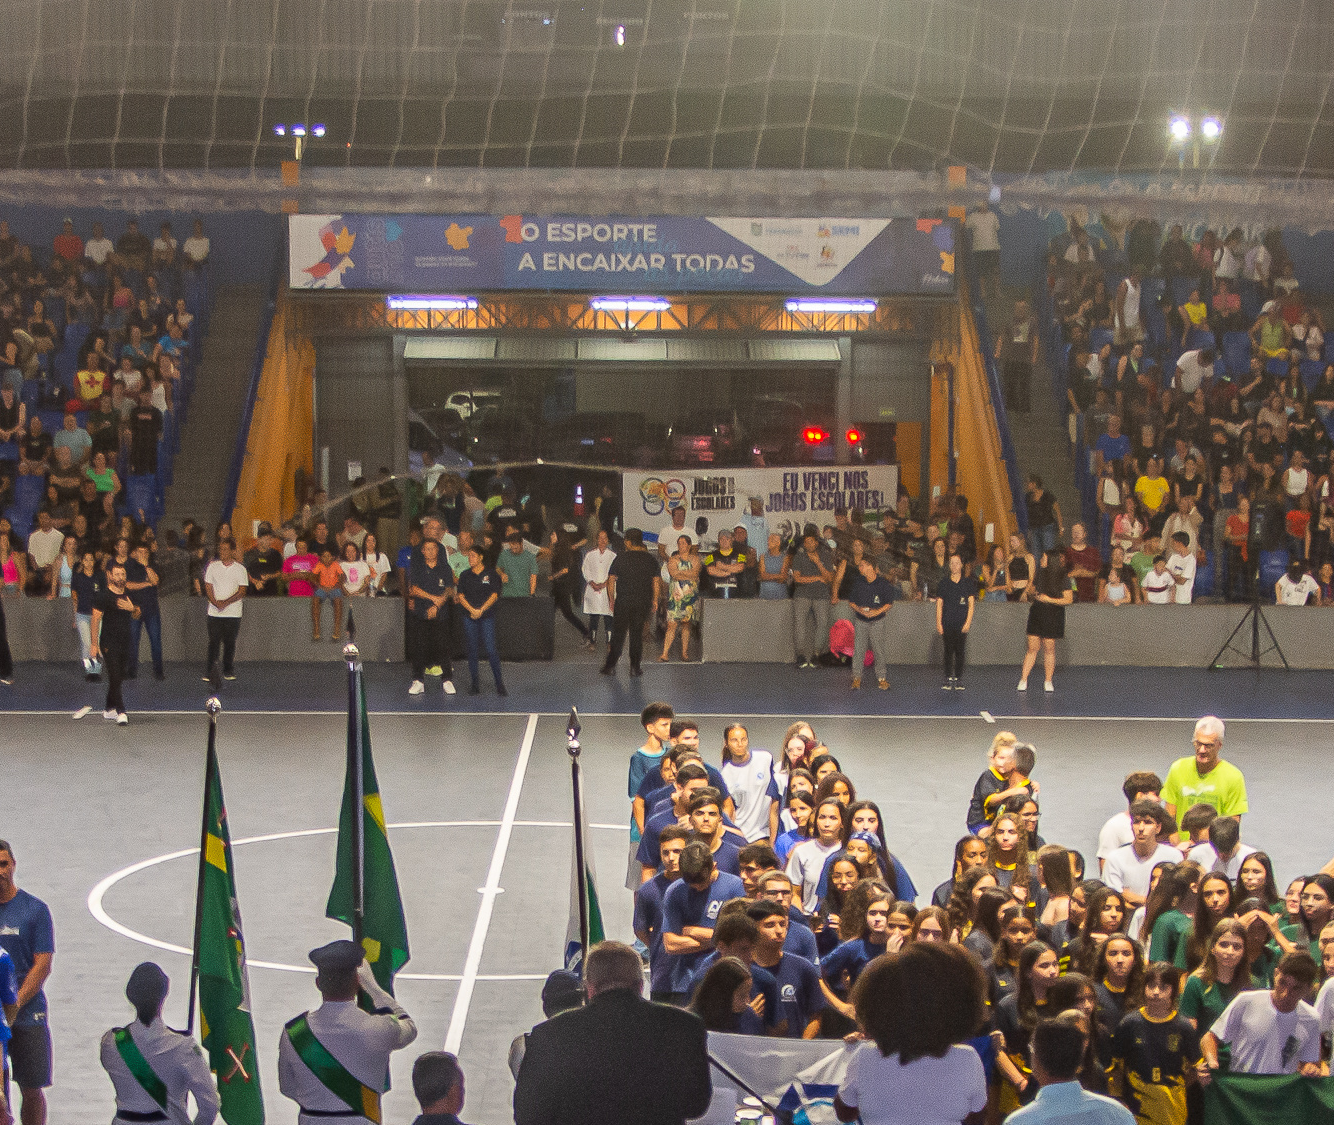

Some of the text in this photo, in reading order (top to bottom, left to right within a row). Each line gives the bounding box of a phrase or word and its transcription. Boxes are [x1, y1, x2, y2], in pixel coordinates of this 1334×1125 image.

[520, 223, 540, 242] O
[547, 223, 657, 243] ESPORTE
[518, 252, 536, 271] A
[543, 252, 666, 272] ENCAIXAR
[672, 253, 755, 273] TODAS
[783, 471, 868, 491] EU VENCI NOS
[766, 490, 884, 512] JOGOS ESCOLARES!
